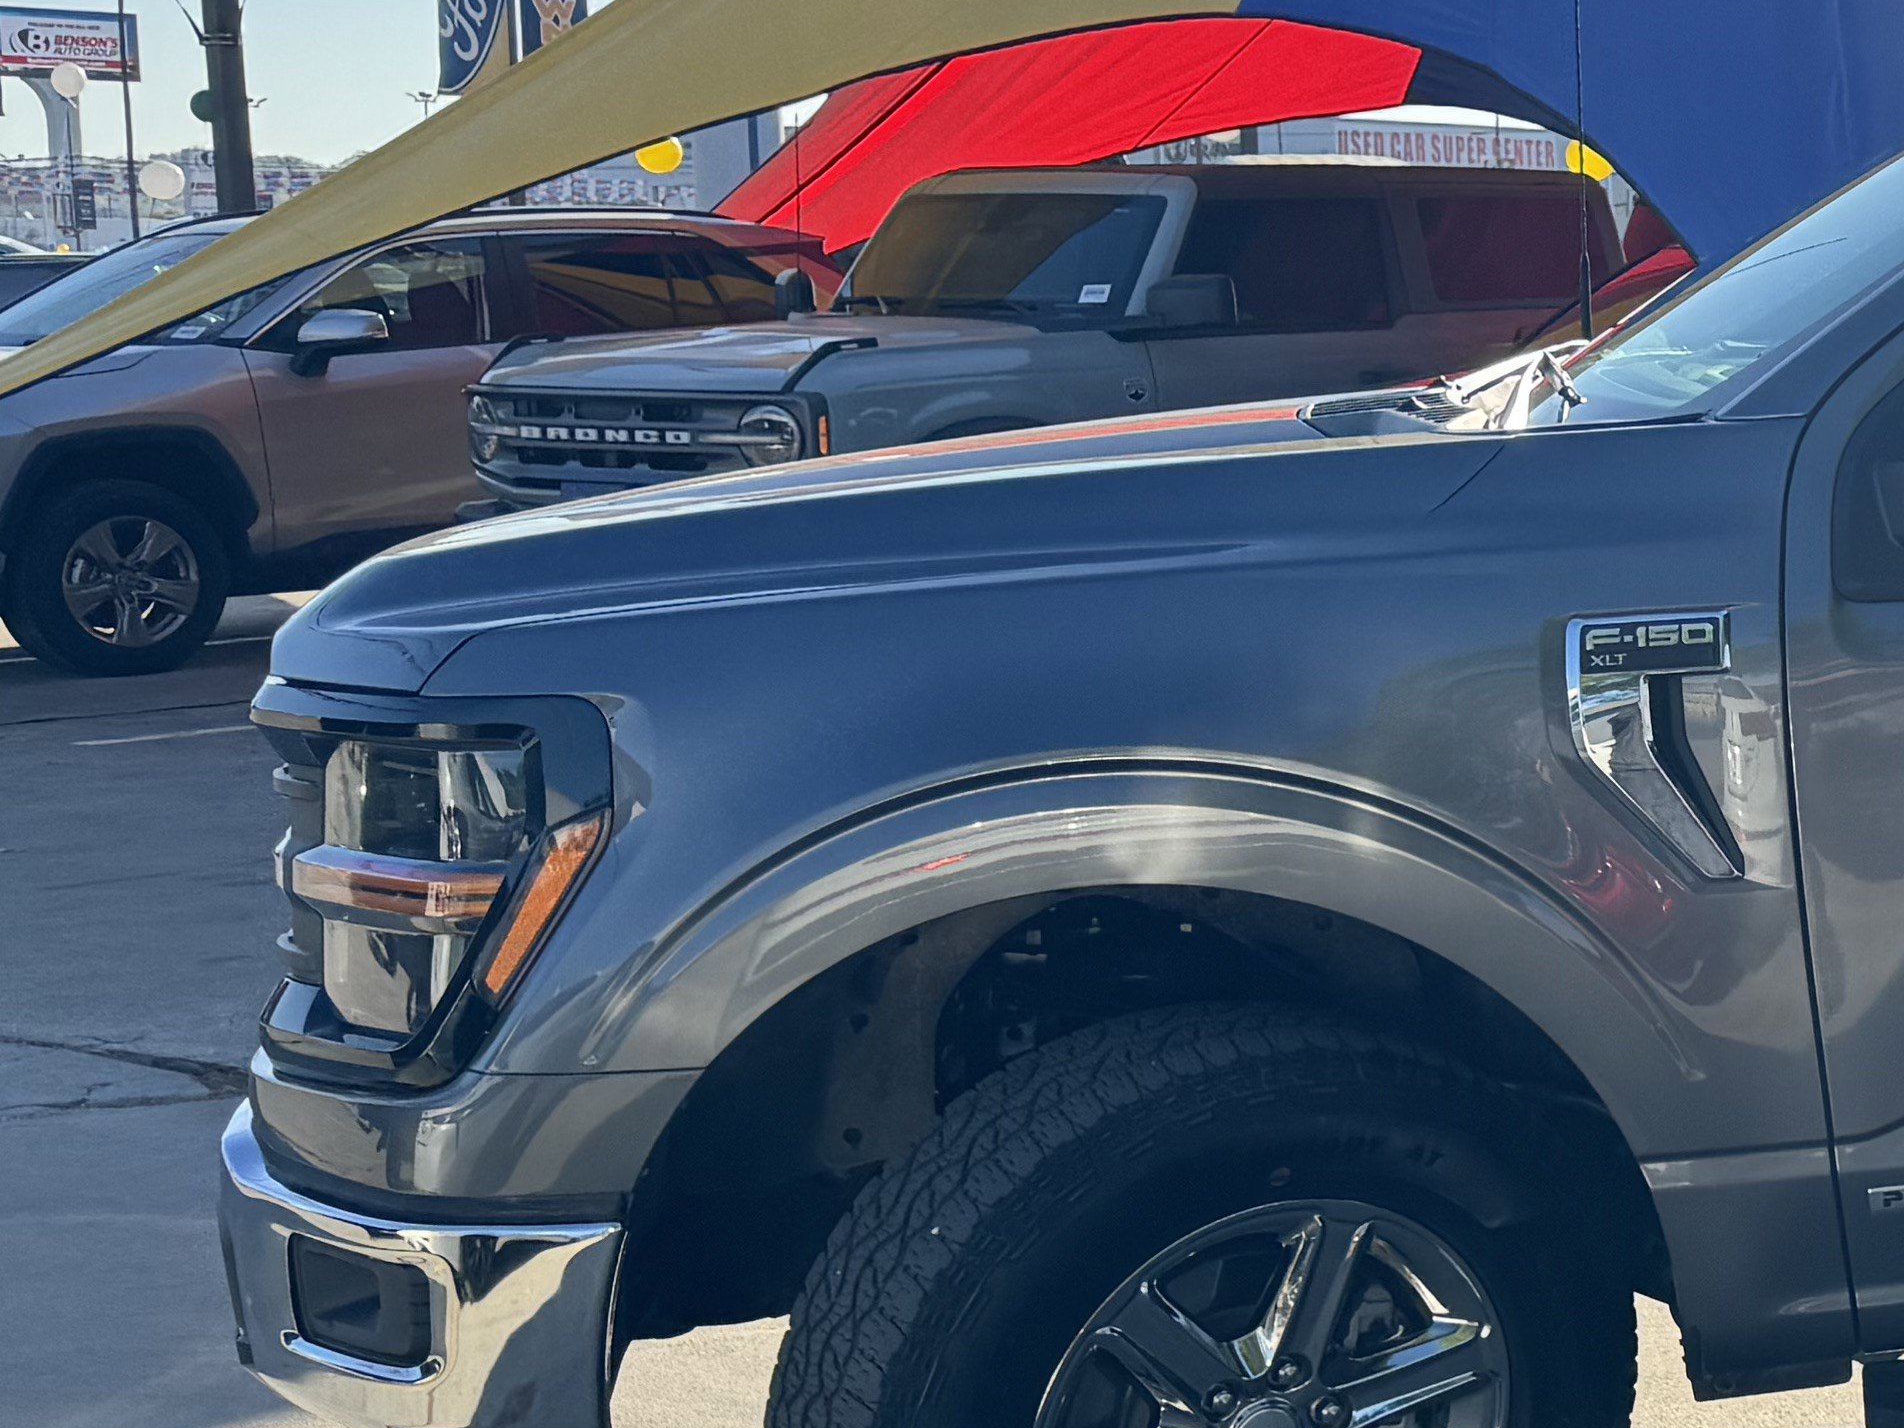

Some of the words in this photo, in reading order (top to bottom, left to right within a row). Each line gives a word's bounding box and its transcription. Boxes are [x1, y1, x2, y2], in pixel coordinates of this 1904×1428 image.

[54, 34, 118, 49] BENSON'S
[53, 46, 81, 56] AUTO
[1338, 130, 1384, 156] USED
[1391, 132, 1425, 162] CAR
[1431, 133, 1486, 165] SUPER
[1492, 137, 1554, 168] CENTER
[520, 425, 691, 444] BRONCO
[1585, 622, 1714, 651] F-150
[1590, 653, 1627, 667] XLT
